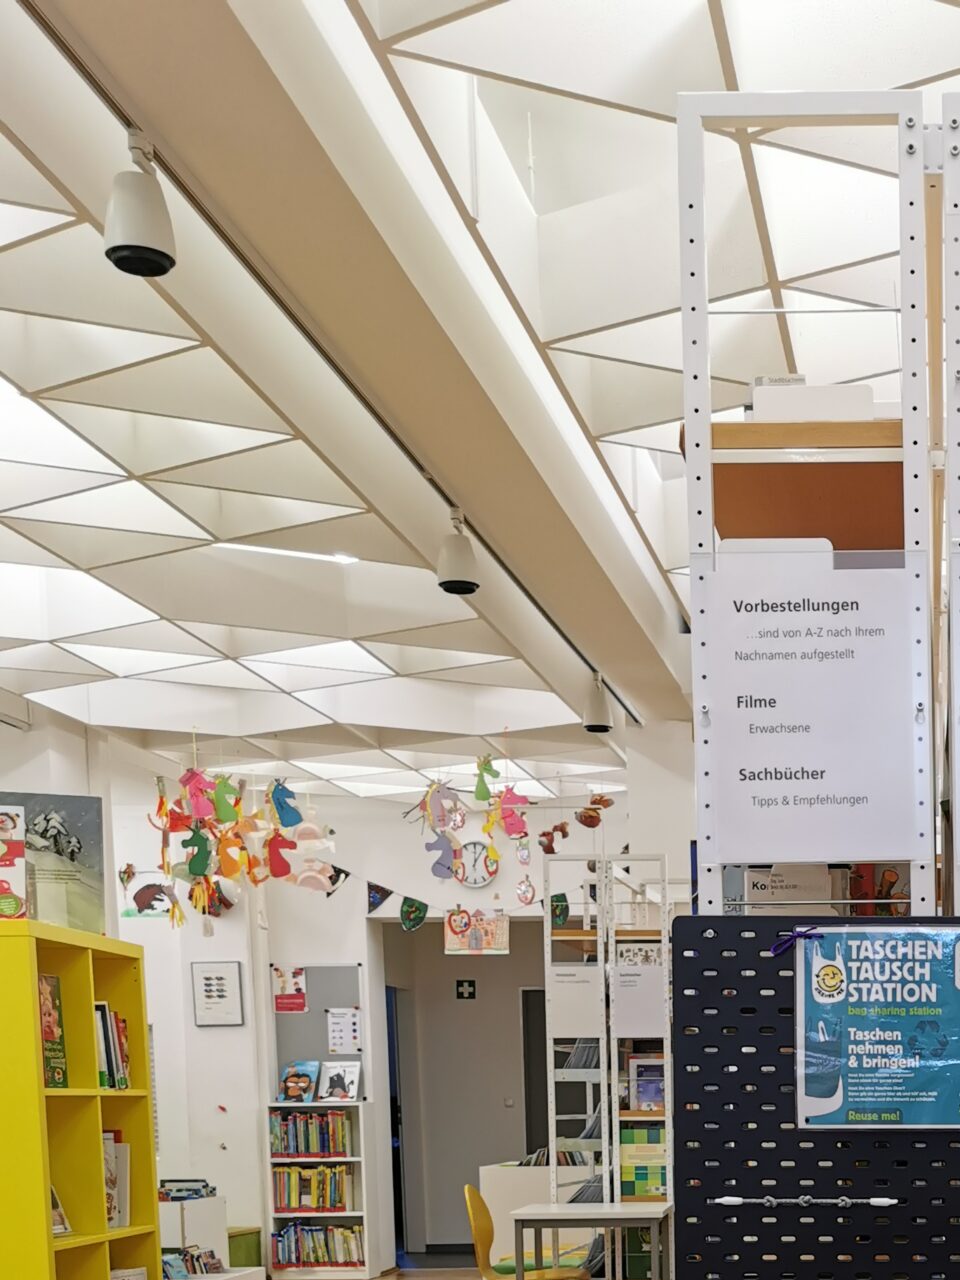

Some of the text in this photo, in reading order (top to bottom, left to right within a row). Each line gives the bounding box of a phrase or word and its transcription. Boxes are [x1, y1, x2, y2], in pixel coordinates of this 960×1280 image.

[733, 598, 859, 615] Vorbestellungen
[782, 630, 801, 639] von
[805, 627, 824, 638] A-Z
[826, 626, 851, 638] nach
[855, 626, 885, 637] Ihrem
[734, 649, 855, 662] Nachnamen aufgestellt
[737, 695, 777, 708] Filme
[749, 723, 811, 734] Erwachsene
[739, 767, 826, 781] Sachbücher
[752, 794, 869, 808] Tipps & Empfehlungen
[848, 940, 943, 960] TASCHEN
[848, 961, 931, 981] TAUSCH
[848, 983, 937, 1003] STATION
[848, 1005, 942, 1017] bag sharing station
[848, 1027, 902, 1040] Taschen
[848, 1041, 903, 1055] nehmen
[848, 1055, 920, 1069] & bringen!
[848, 1110, 900, 1121] Reuse me!
